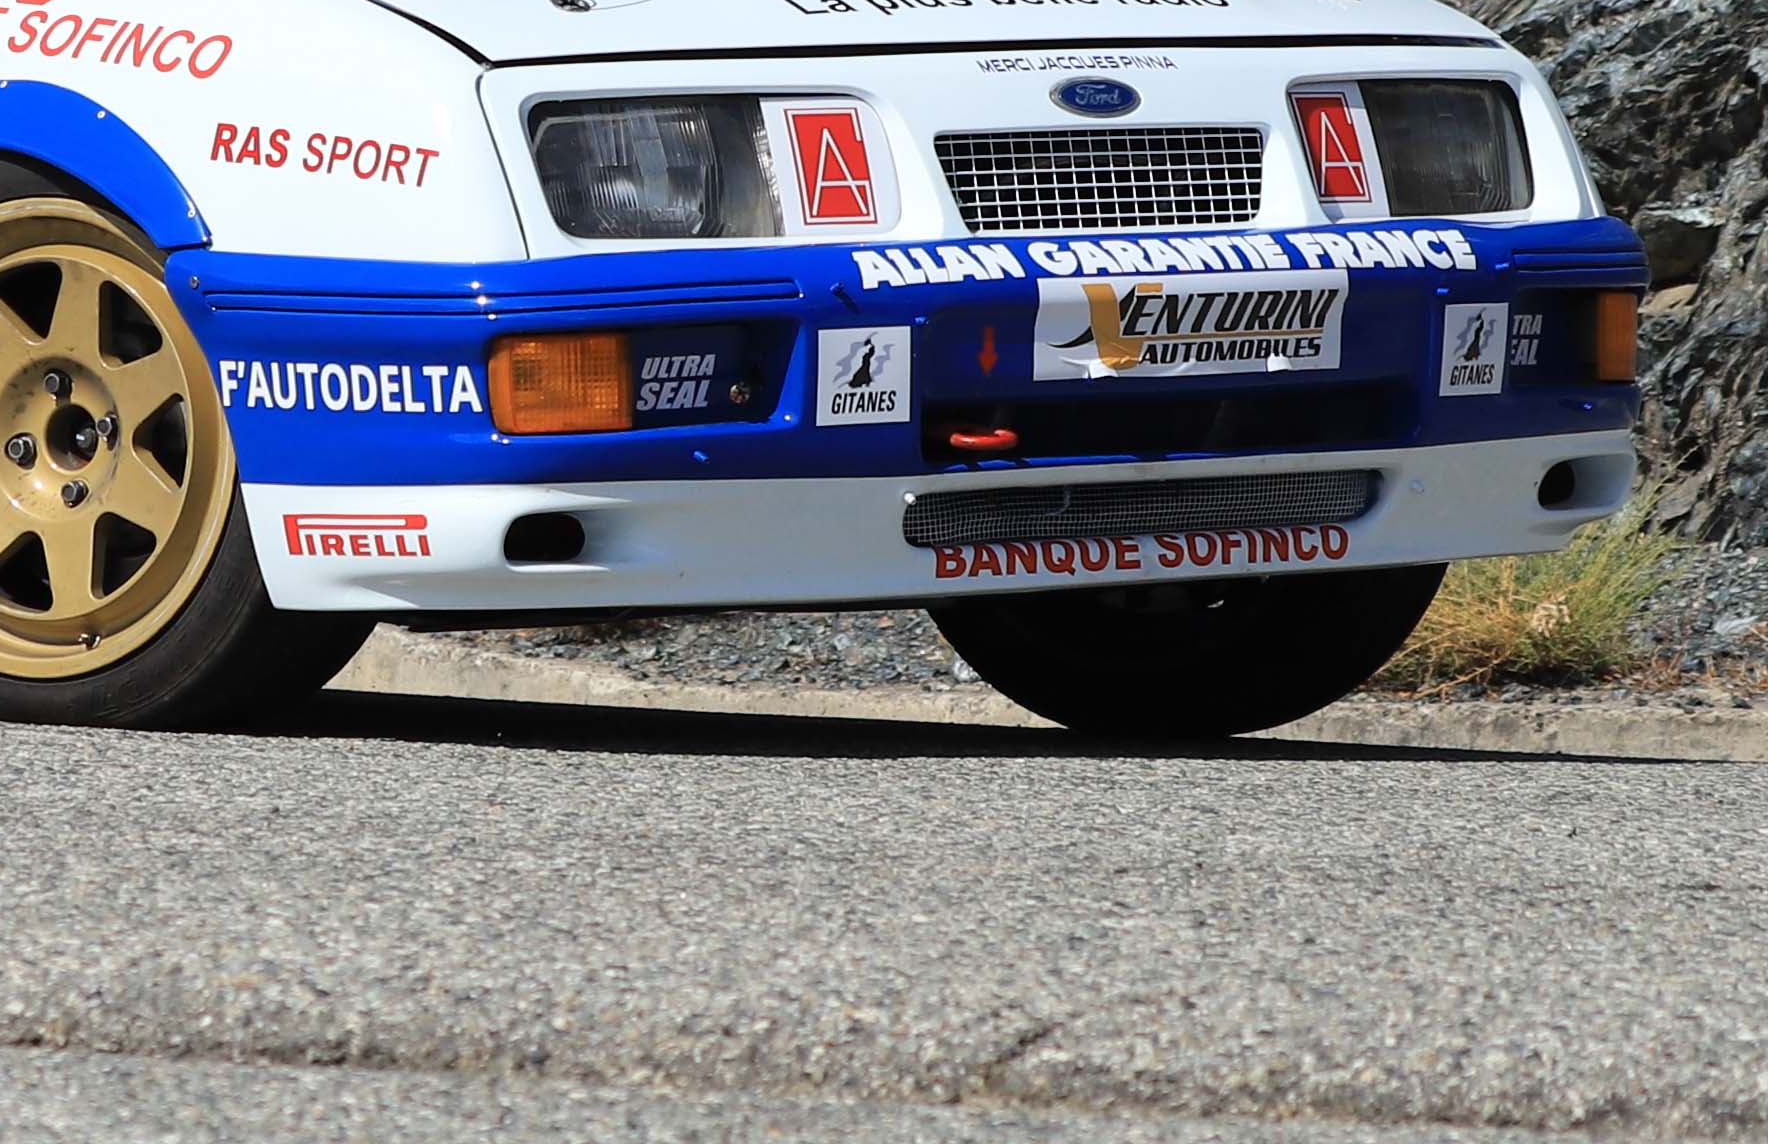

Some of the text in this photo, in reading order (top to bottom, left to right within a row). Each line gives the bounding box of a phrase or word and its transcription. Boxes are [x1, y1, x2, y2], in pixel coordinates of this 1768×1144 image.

[7, 10, 233, 79] SOFINCO
[977, 55, 1177, 74] MERCI JACQUES PINNA
[1074, 83, 1122, 107] Ford
[210, 122, 440, 188] RAS SPORT
[850, 227, 1477, 292] ALLAN GARANTIE FRANCE
[1081, 283, 1340, 364] VENTURINI
[1512, 313, 1544, 336] TRA
[1139, 335, 1322, 365] AUTOMOBILES
[640, 353, 715, 381] ULTRA
[1449, 362, 1496, 387] GITANES
[636, 380, 712, 412] SEAL
[830, 389, 898, 416] GITANES
[282, 513, 432, 558] PIRELLI
[935, 523, 1350, 580] BANQUE SOFINCO
